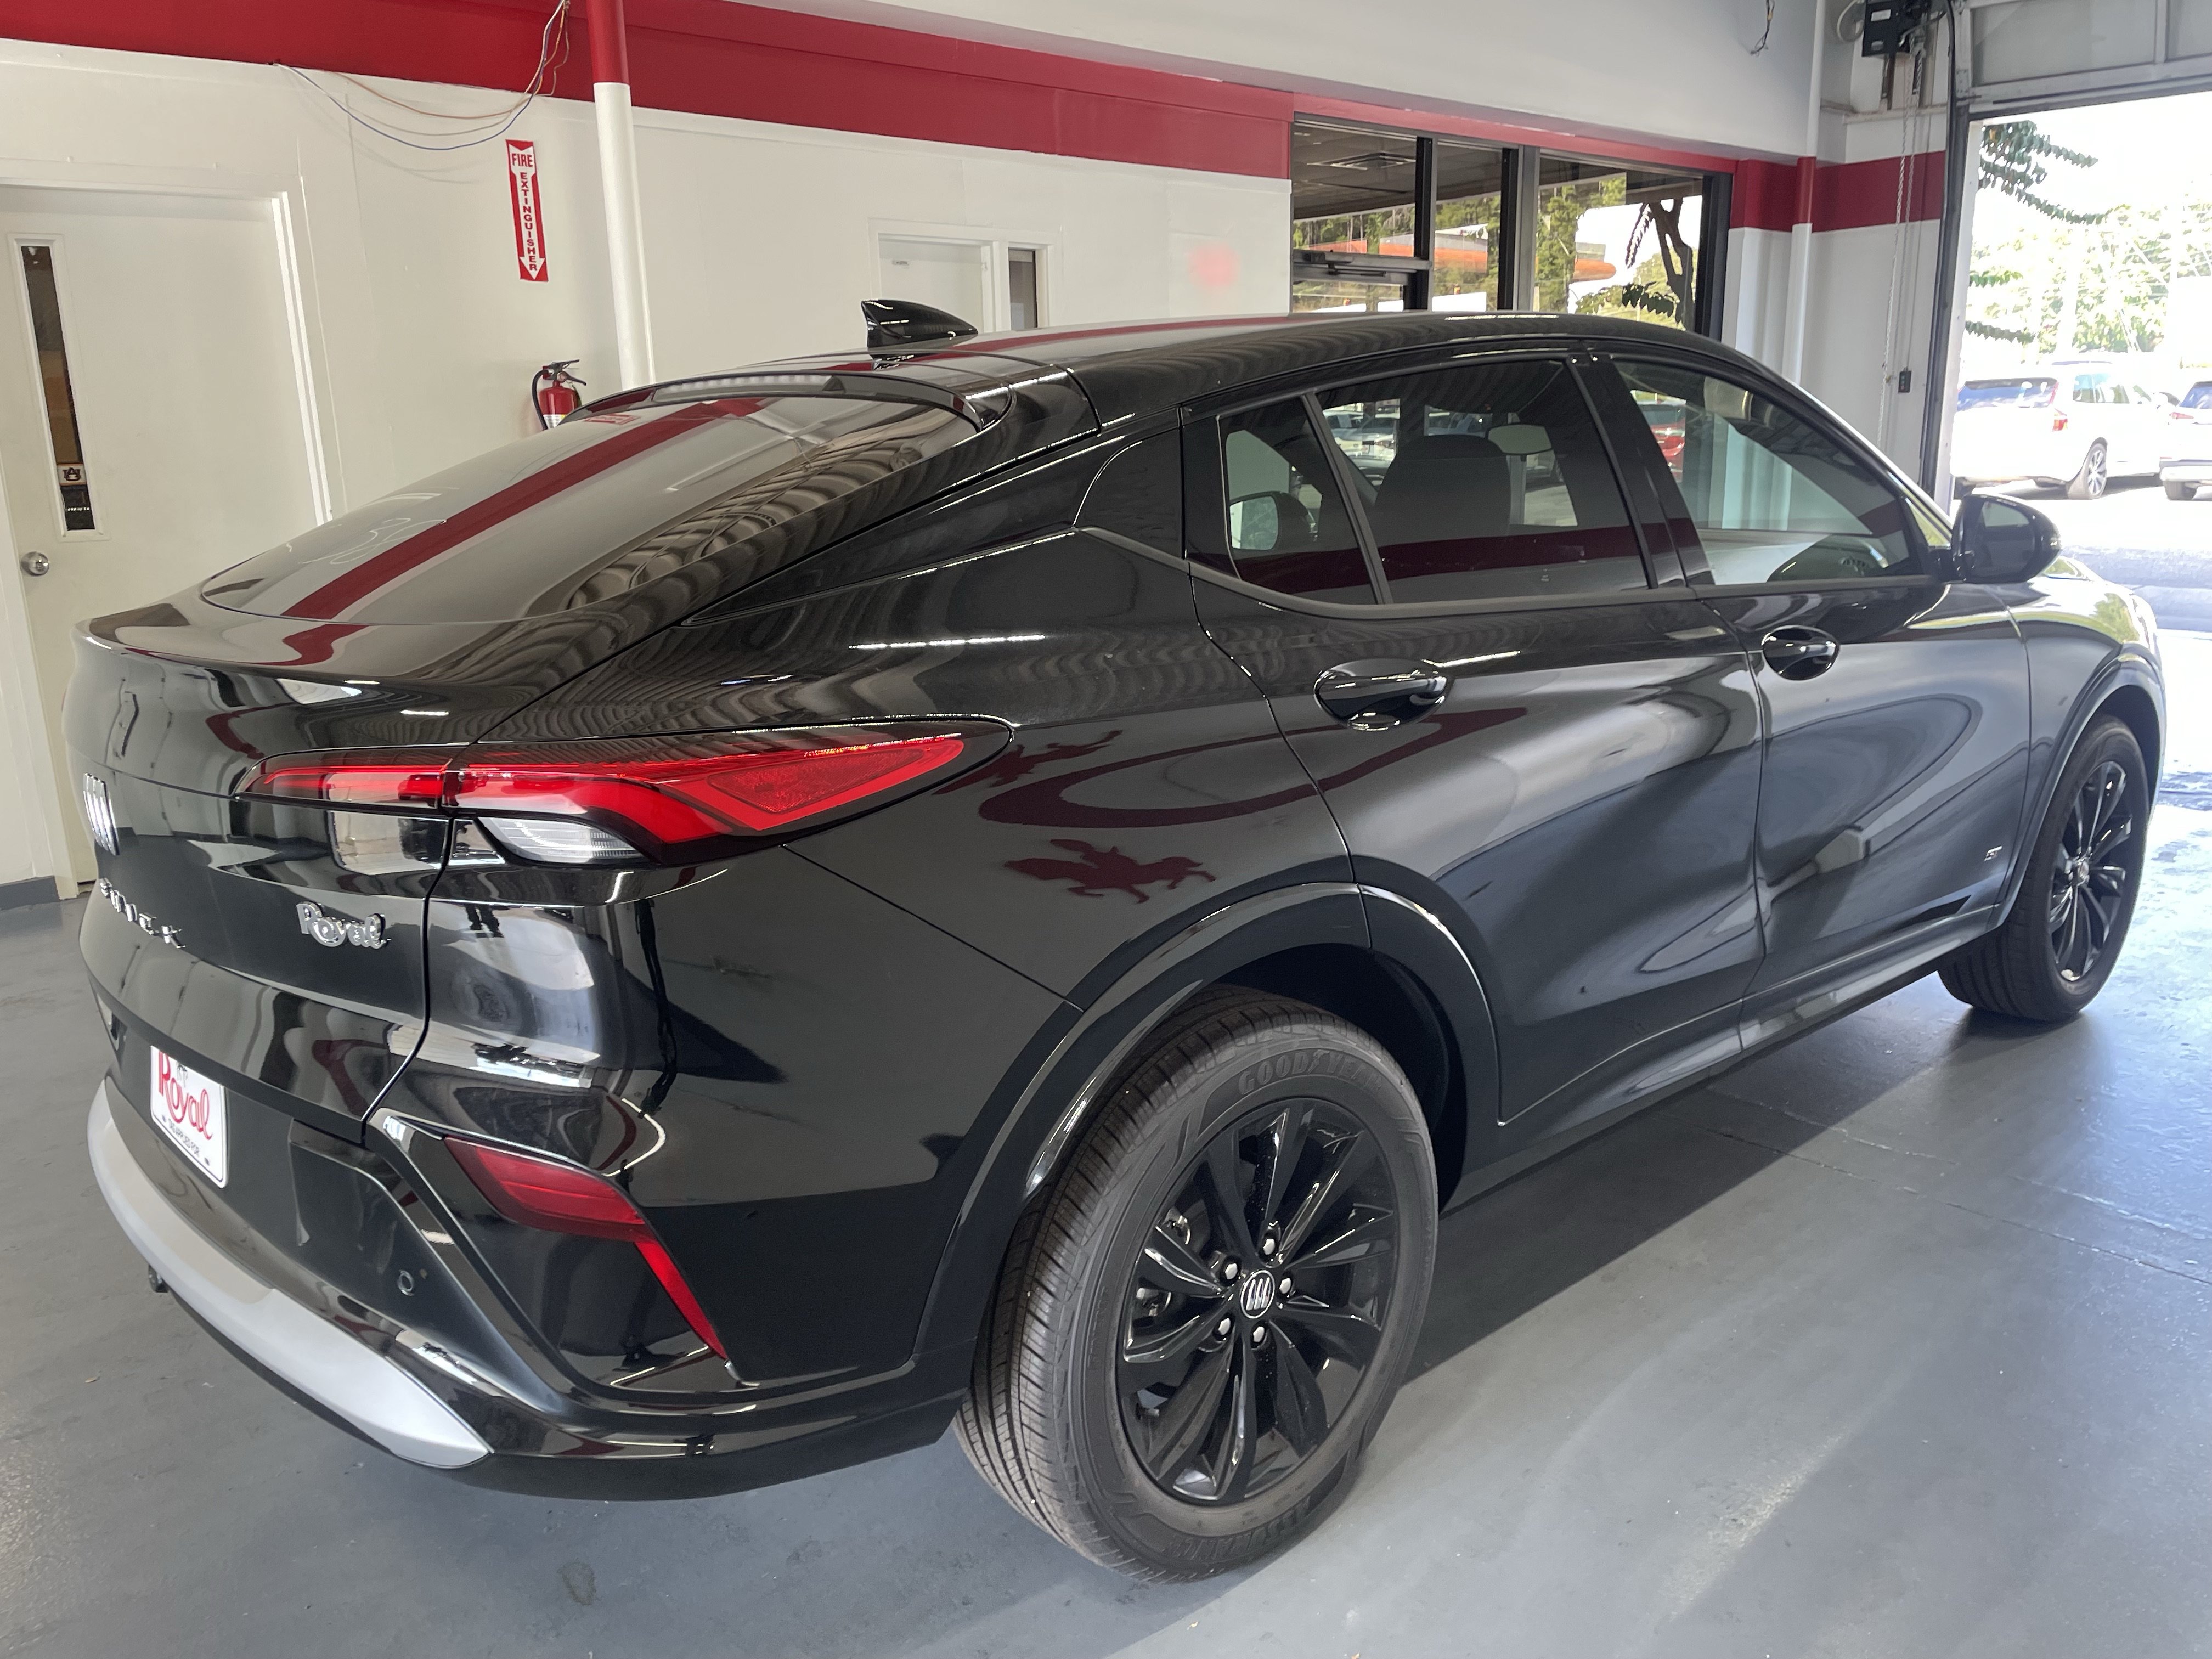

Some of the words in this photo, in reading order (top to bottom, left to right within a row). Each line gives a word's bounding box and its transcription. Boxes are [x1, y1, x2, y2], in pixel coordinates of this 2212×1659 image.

[511, 153, 533, 167] FIRE
[520, 172, 537, 271] EXTINGUISHER
[296, 901, 387, 949] Royal
[159, 1051, 213, 1141] Royal
